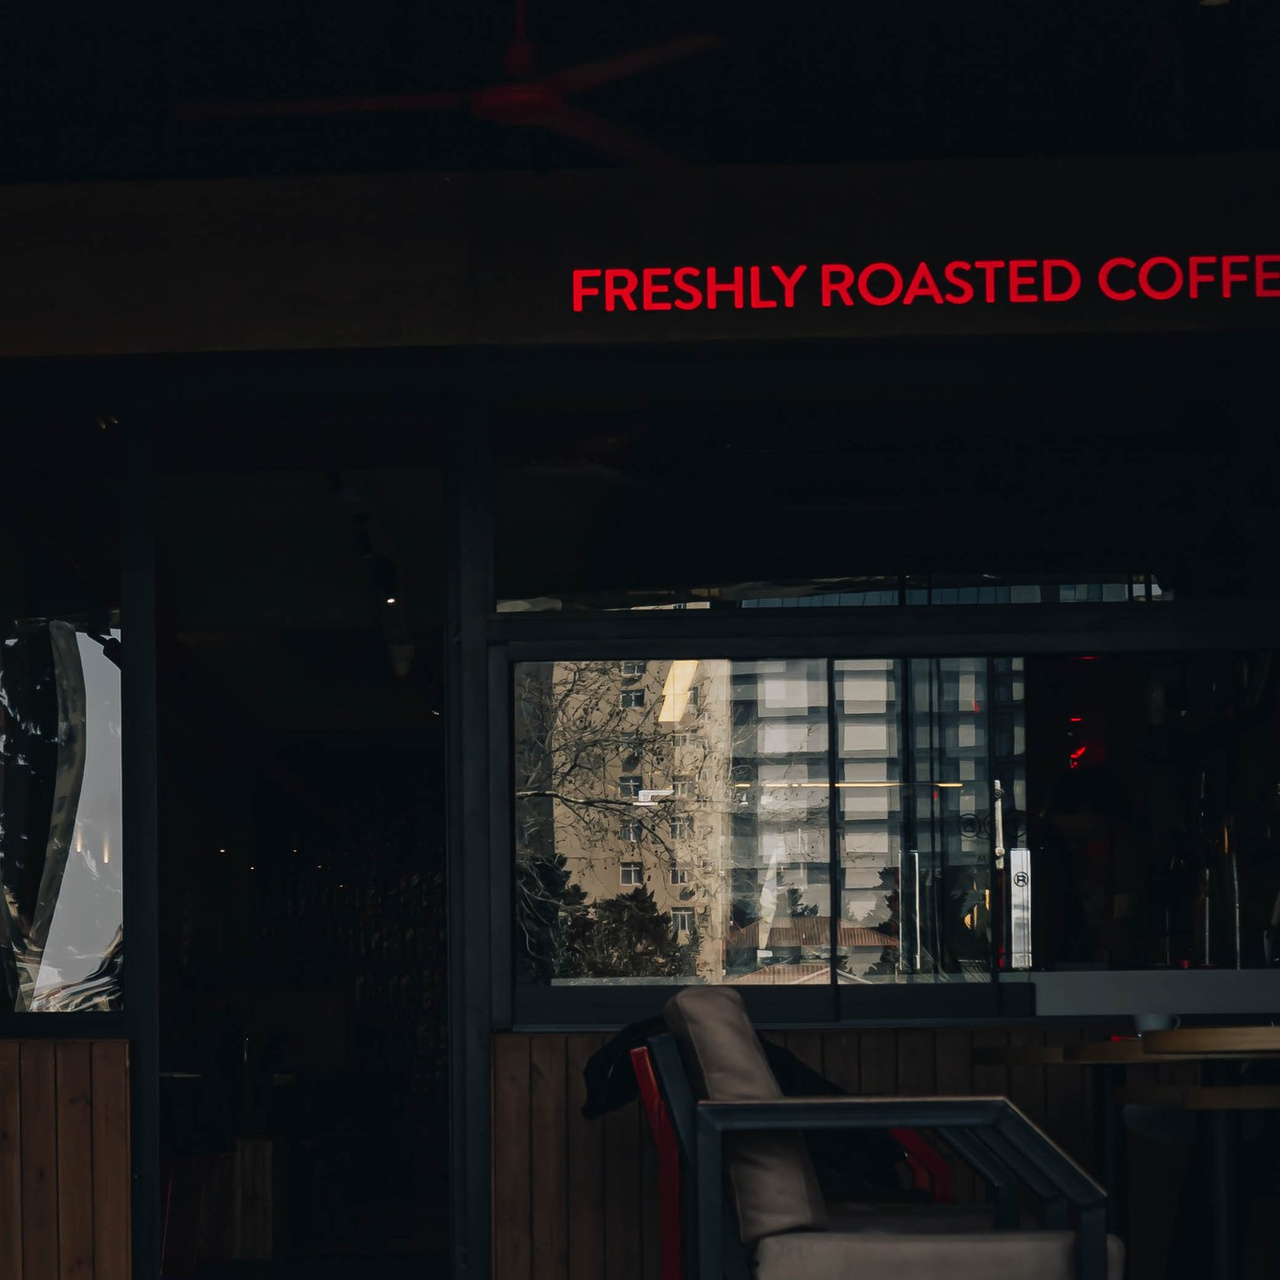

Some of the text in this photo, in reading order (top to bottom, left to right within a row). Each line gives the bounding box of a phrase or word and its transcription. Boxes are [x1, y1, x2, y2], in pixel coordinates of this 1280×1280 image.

[572, 254, 1280, 312] FRESHLY ROASTED COFFE
